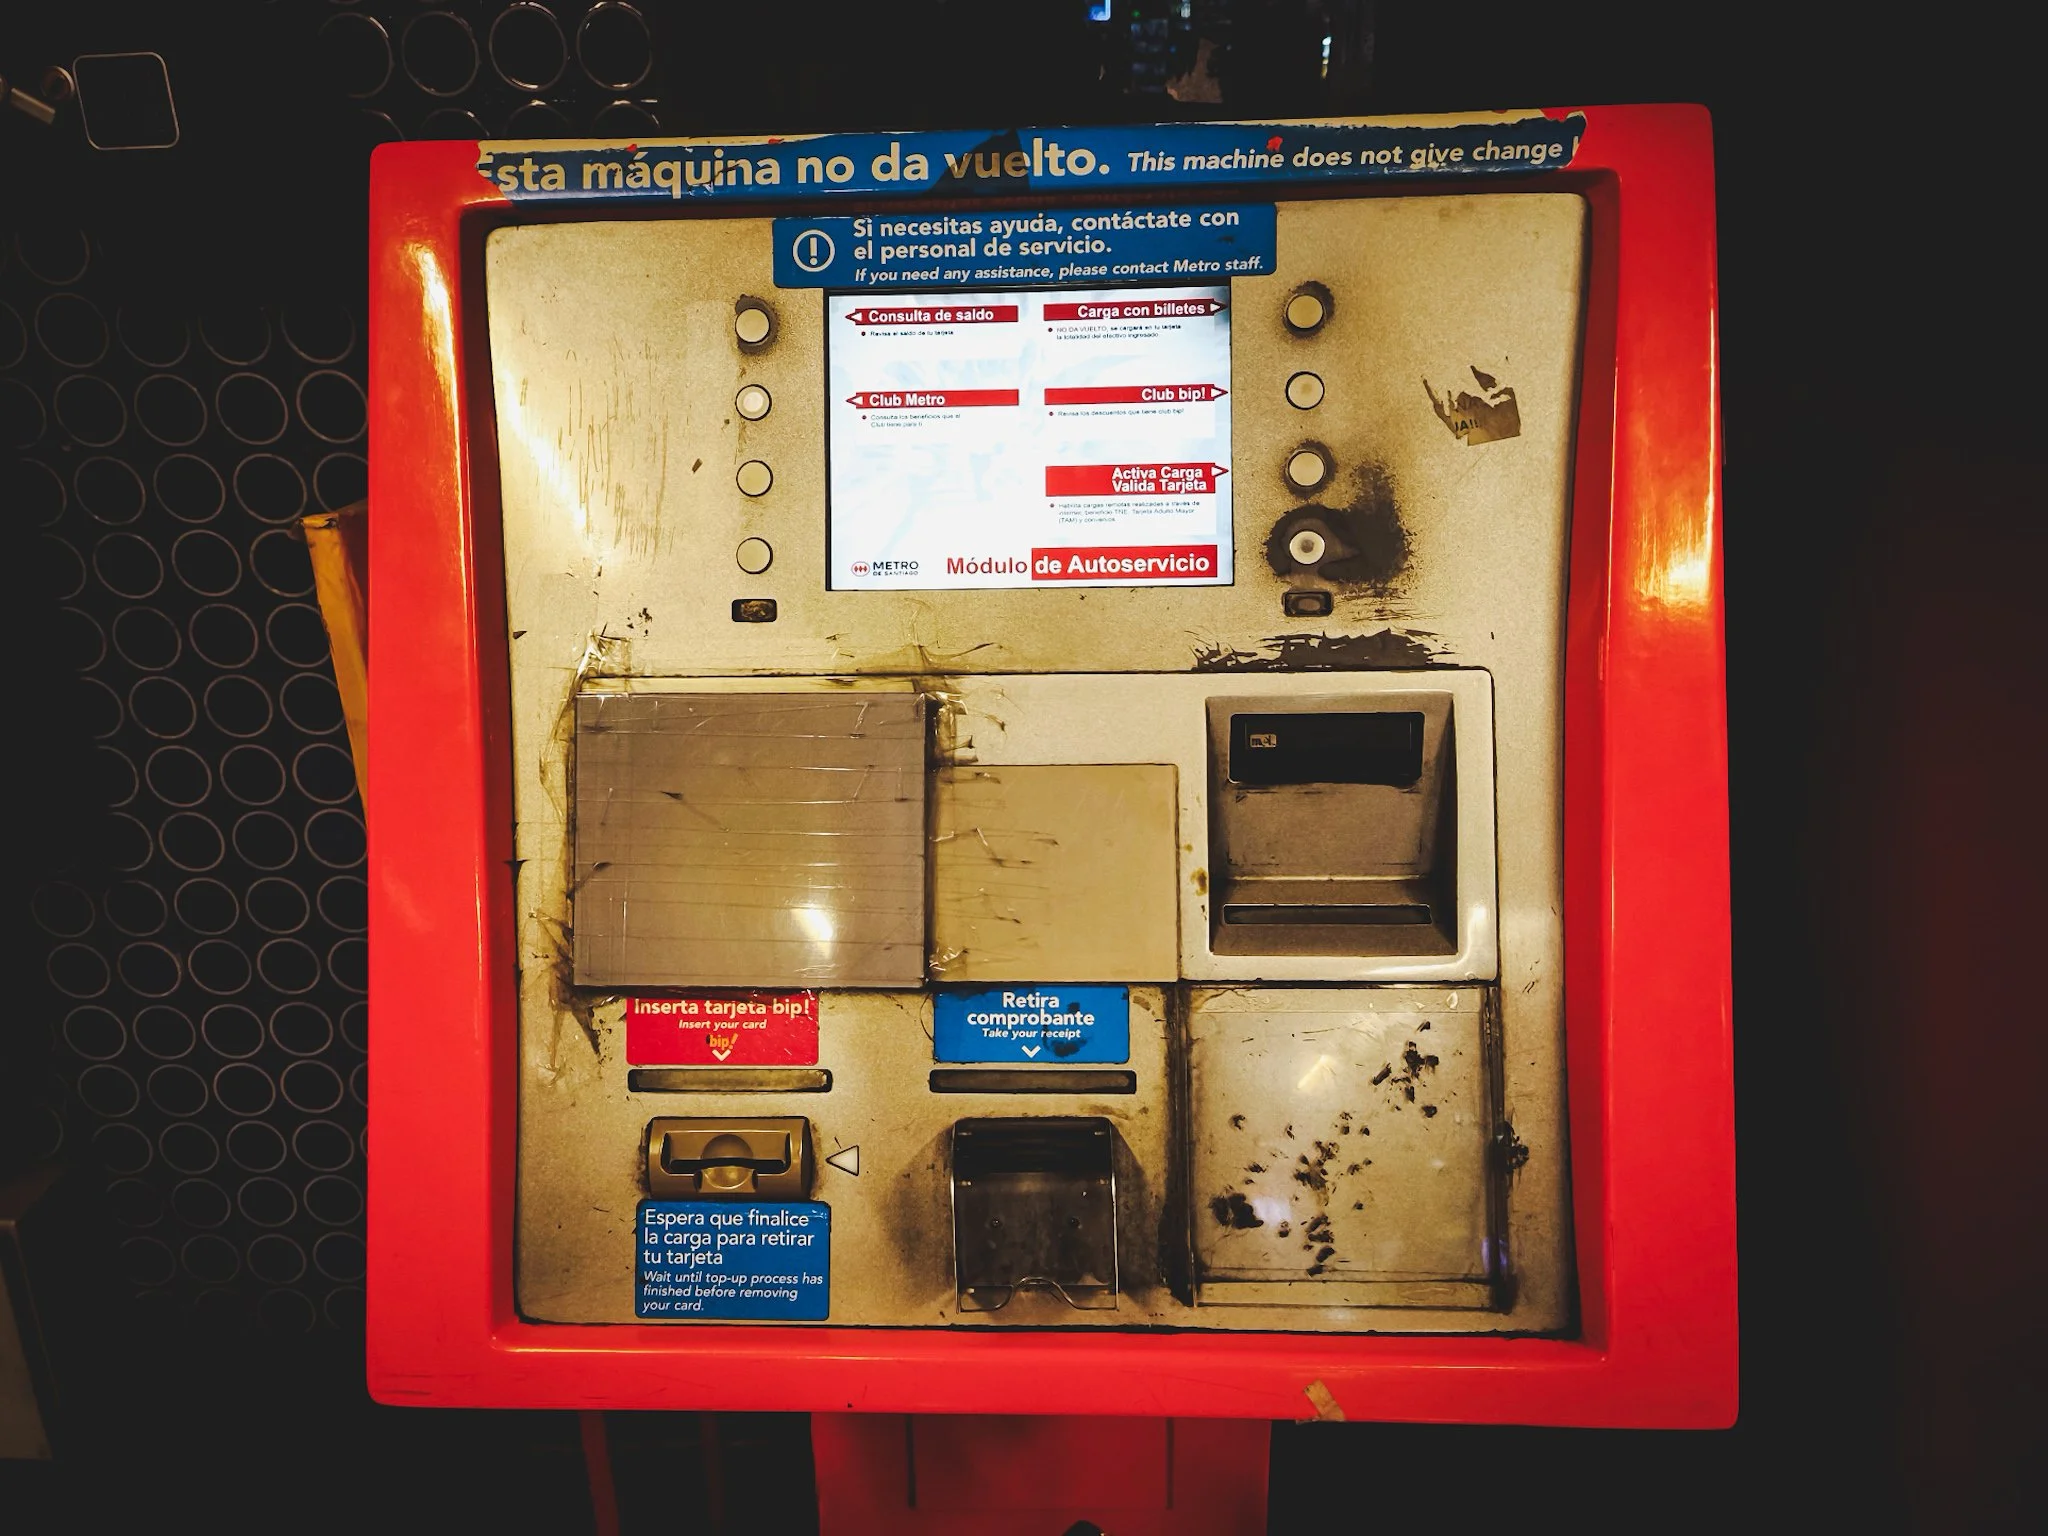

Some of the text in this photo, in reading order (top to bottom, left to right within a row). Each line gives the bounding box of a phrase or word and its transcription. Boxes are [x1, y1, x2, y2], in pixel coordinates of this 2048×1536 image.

[1128, 151, 1176, 172] This
[1183, 148, 1285, 171] machine
[1292, 146, 1353, 167] does
[1360, 146, 1403, 165] not
[1410, 143, 1464, 169] give
[1472, 139, 1563, 165] change
[582, 149, 781, 199] máquina
[797, 155, 855, 184] no
[871, 141, 929, 182] da
[944, 137, 1110, 179] vuelto.
[880, 216, 983, 237] necesitas
[989, 212, 1064, 239] ayuda,
[1071, 210, 1192, 232] contáctate
[1199, 211, 1240, 227] con
[853, 235, 1112, 265] el personal de servicio.
[855, 255, 1264, 286] If you need any assistance, please contact Metro staff.
[868, 308, 994, 323] Consulta de saldo
[1077, 303, 1206, 319] Carga con billetes
[869, 393, 946, 407] Club Metro
[1141, 387, 1206, 402] Club bip!
[1112, 466, 1203, 480] Activa Carga
[1112, 478, 1207, 494] Valida Tarjeta
[872, 560, 919, 570] METRO
[946, 553, 1210, 574] Módulo de Autoservicio
[635, 998, 810, 1019] Inserta tarjeta bip!
[1001, 991, 1060, 1009] Retira
[678, 1019, 768, 1032] Insert your card
[966, 1008, 1096, 1030] comprobante
[708, 1033, 739, 1050] bip!
[982, 1027, 1081, 1040] Take your receipt
[644, 1208, 809, 1231] Espera que finalice
[644, 1228, 815, 1251] la carga para retirar
[643, 1249, 723, 1269] tu tarjeta
[643, 1271, 823, 1287] Wait until top-up process has
[643, 1285, 799, 1301] finished before removing
[642, 1299, 705, 1313] your card.
